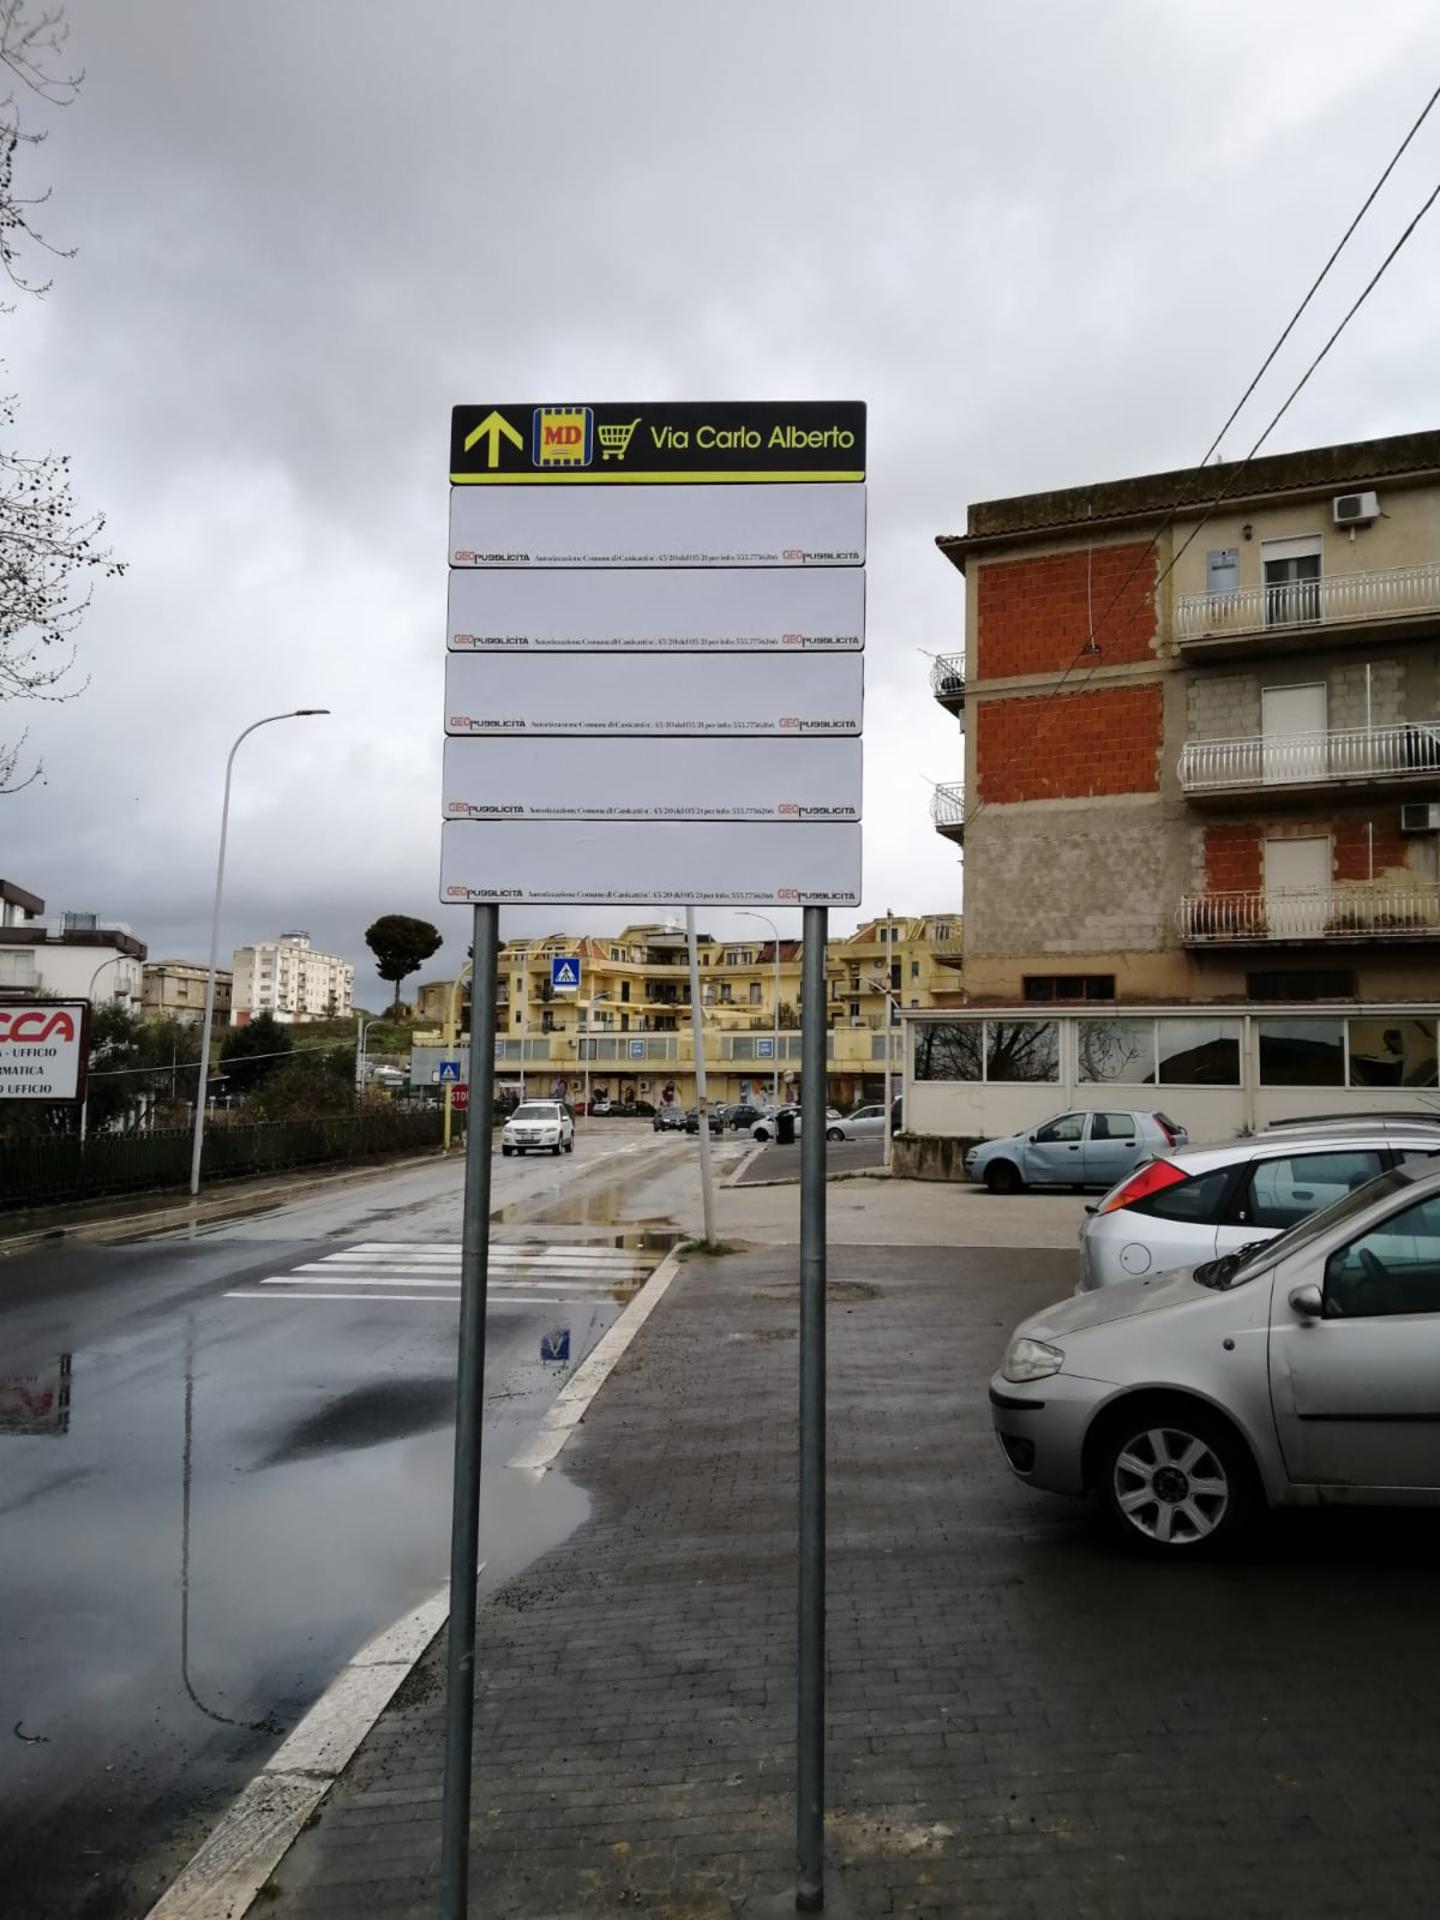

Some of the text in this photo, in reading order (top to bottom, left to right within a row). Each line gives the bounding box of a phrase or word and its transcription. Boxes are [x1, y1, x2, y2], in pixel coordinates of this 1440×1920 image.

[544, 426, 581, 445] MD
[650, 426, 854, 448] Via Carlo Alberto
[13, 1048, 57, 1057] UFFICIO
[0, 1066, 44, 1075] MATICA
[8, 1084, 52, 1094] UFFICIO
